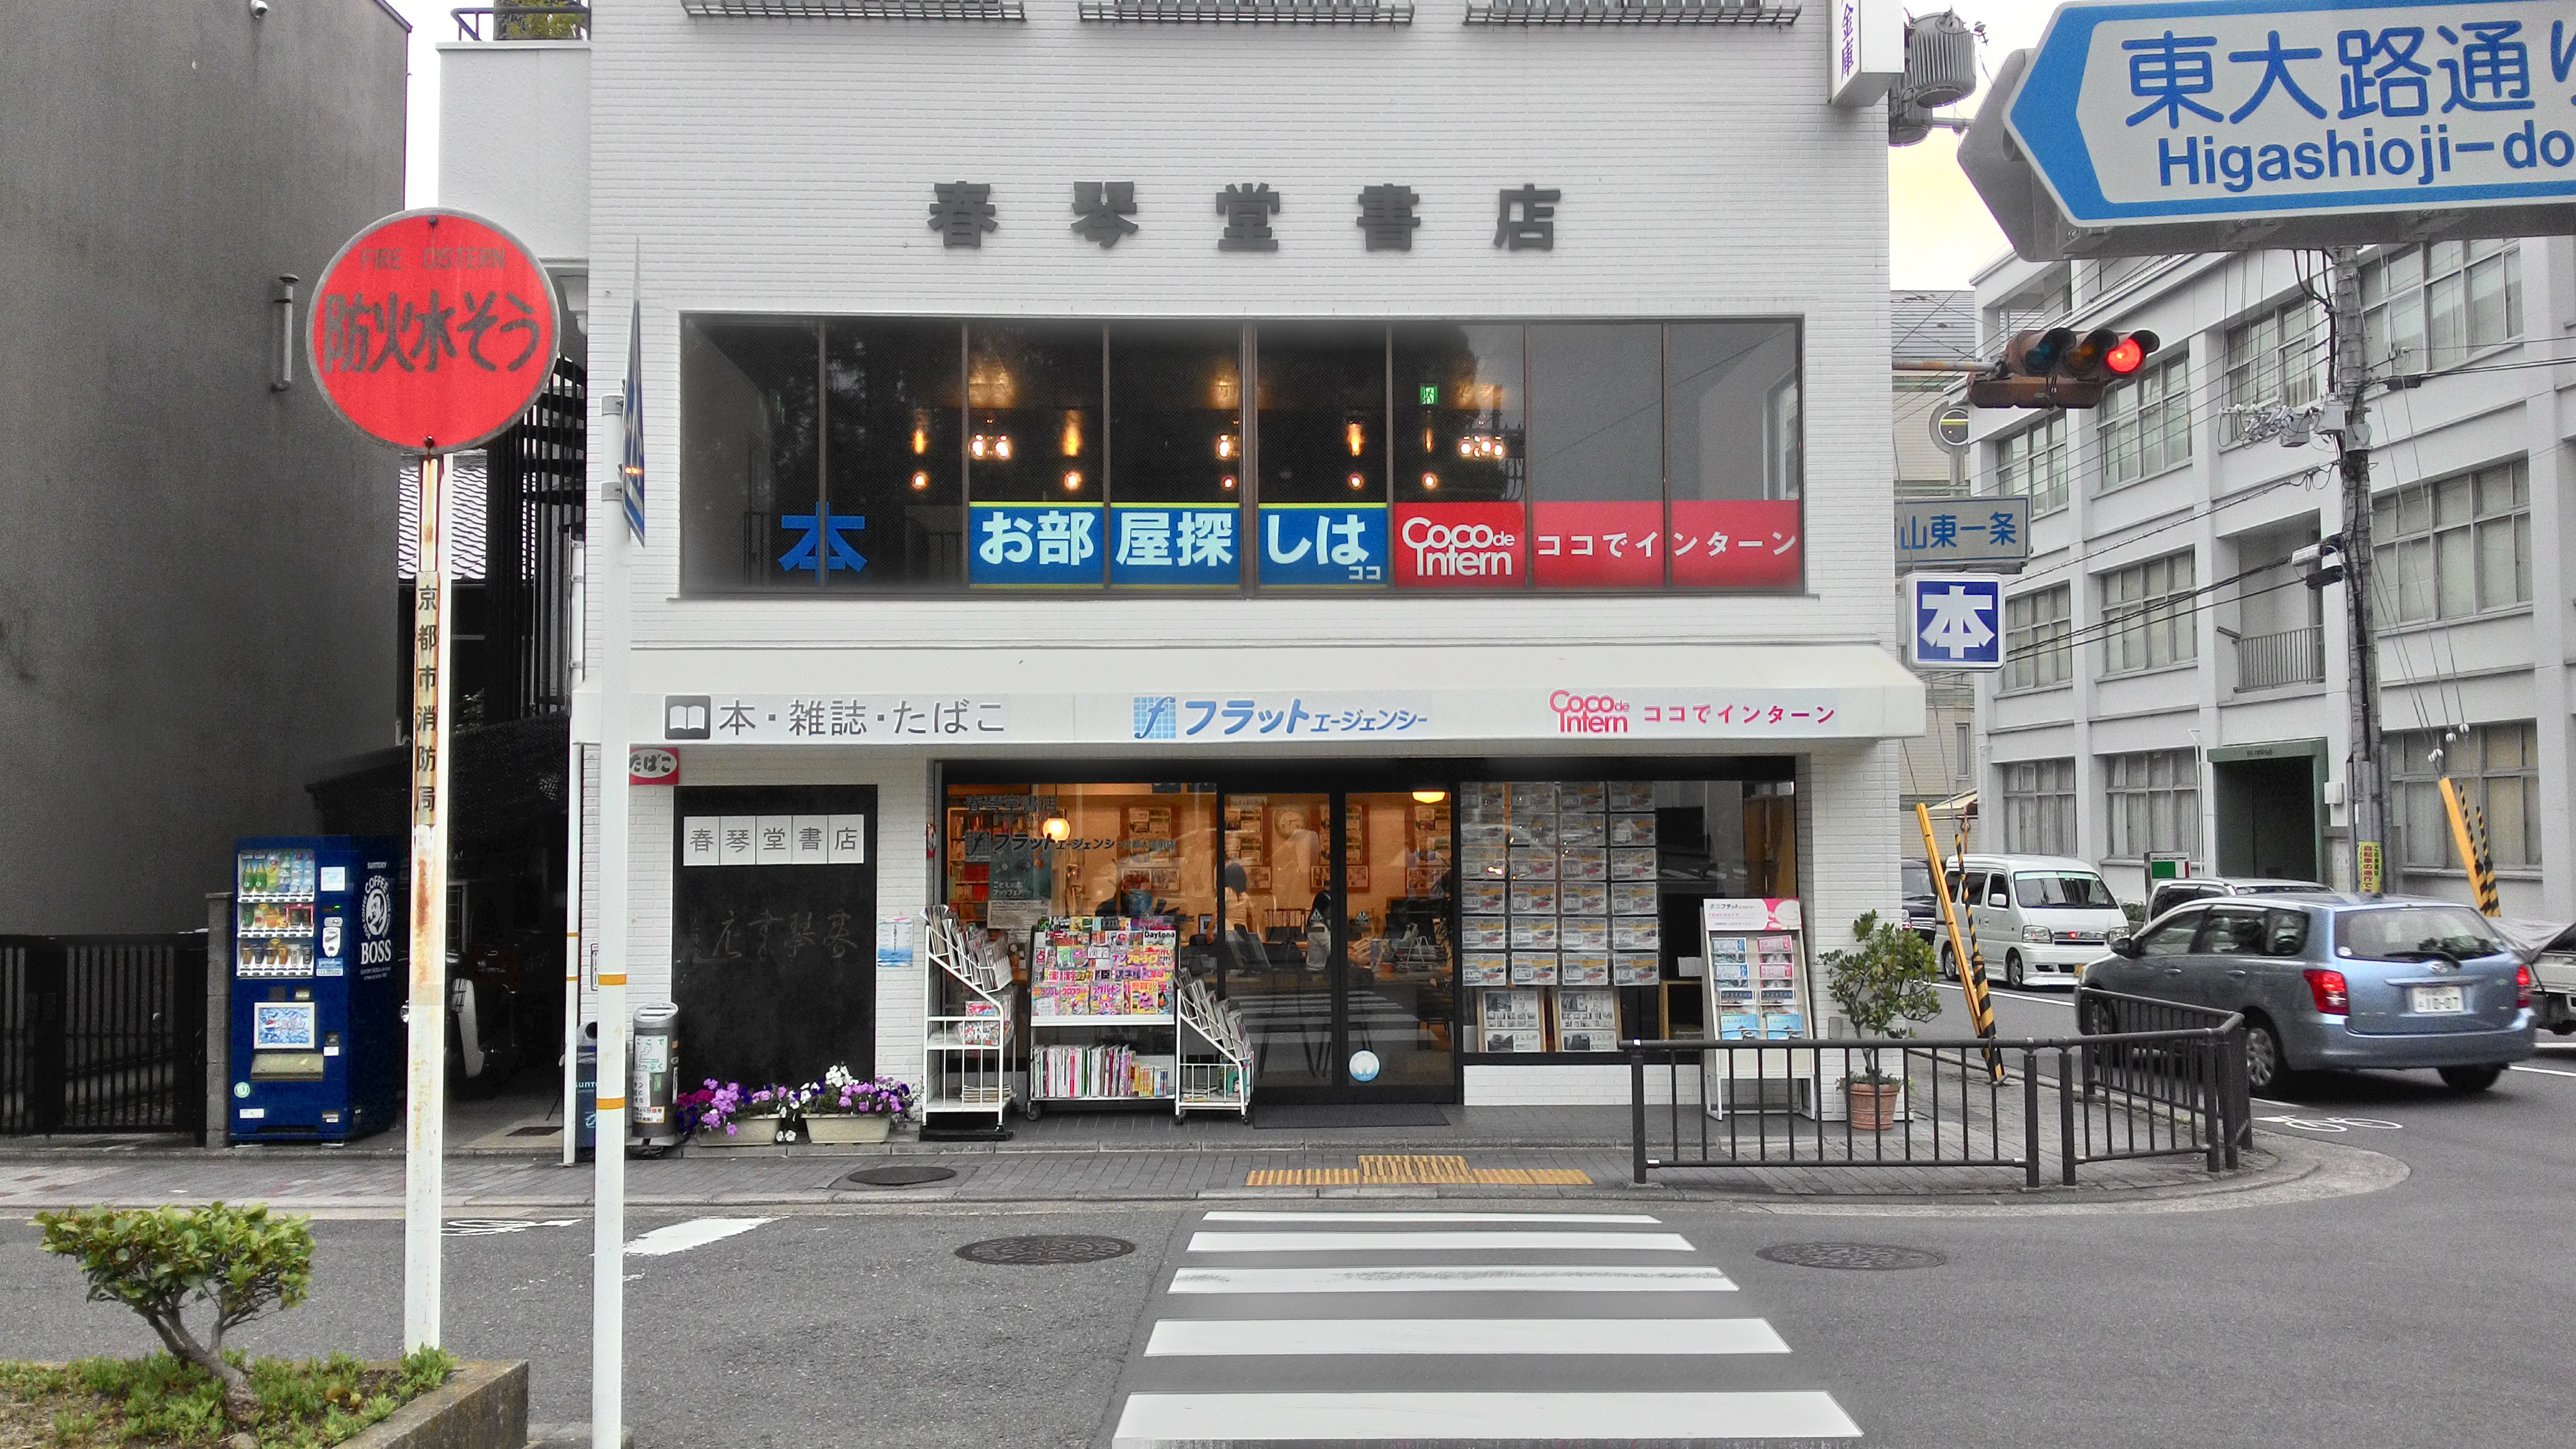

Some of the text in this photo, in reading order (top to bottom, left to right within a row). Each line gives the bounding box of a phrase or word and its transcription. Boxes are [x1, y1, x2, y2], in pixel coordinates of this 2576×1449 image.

[1840, 0, 1855, 82] 金庫
[926, 180, 1561, 252] 春琴堂書店
[360, 247, 402, 270] FIRE
[324, 290, 540, 374] 防火水そう
[778, 501, 868, 586] 本
[979, 510, 1370, 567] お部屋探しは
[1401, 516, 1516, 548] Coco de
[1538, 530, 1797, 558] ココでインターン
[1894, 511, 2016, 550] 山東一条
[1348, 566, 1381, 580] ココ
[1416, 546, 1513, 577] Intern
[1920, 585, 1995, 659] 本
[416, 585, 438, 812] 京都市消防局
[1549, 689, 1630, 714] Coco de
[1558, 712, 1628, 733] Intern
[1644, 704, 1835, 724] ココでインターン
[630, 753, 672, 772] たばこ
[965, 794, 1058, 814] 春琴堂書店
[689, 826, 858, 853] 春琴堂書店
[365, 875, 389, 894] COFFEE
[1144, 931, 1175, 940] Daytona
[360, 939, 391, 965] BOSS
